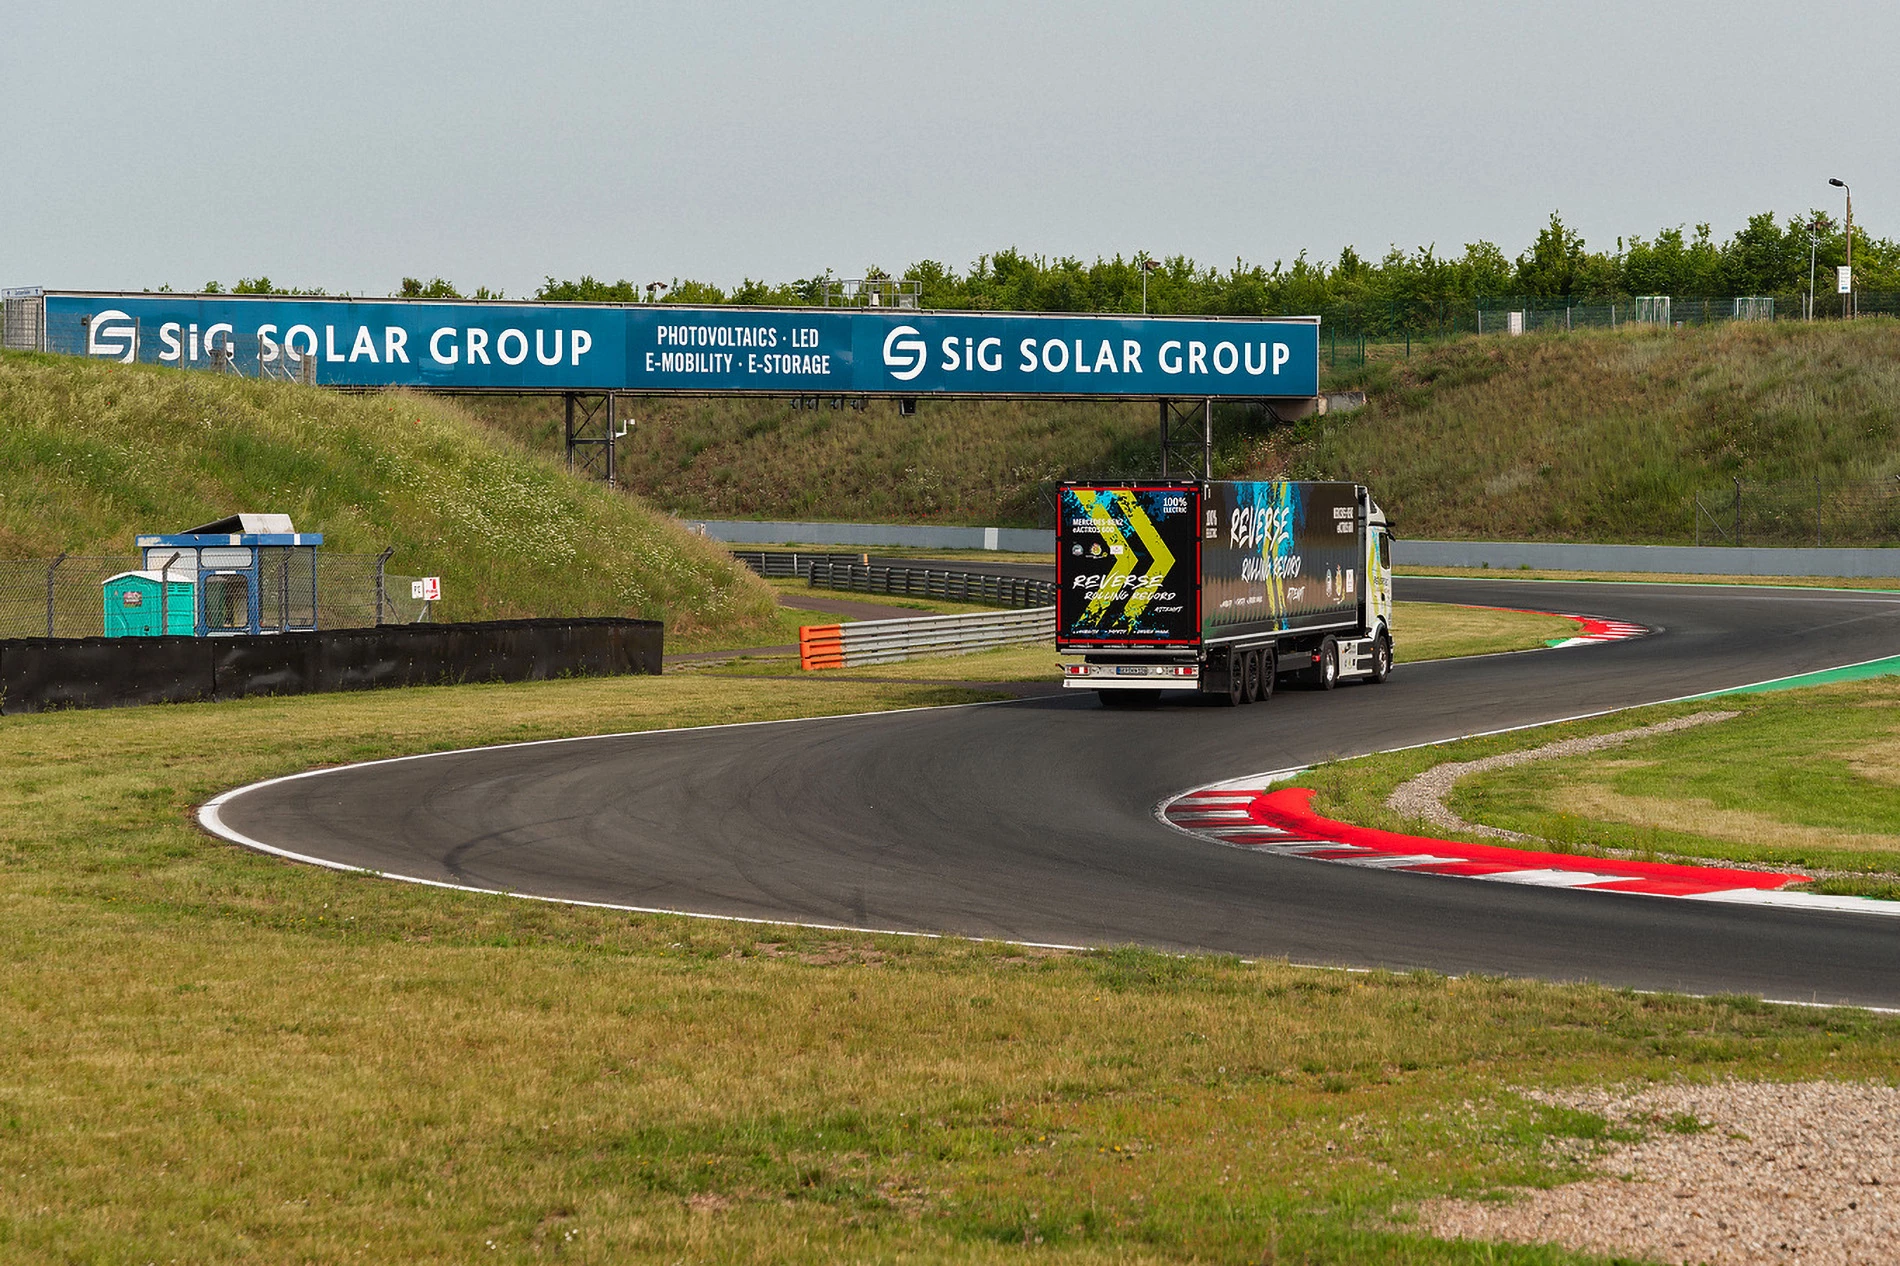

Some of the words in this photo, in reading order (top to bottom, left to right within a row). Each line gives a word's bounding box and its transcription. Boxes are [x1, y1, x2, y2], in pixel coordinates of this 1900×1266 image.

[158, 322, 234, 363] SiG
[256, 323, 410, 364] SOLAR
[430, 327, 592, 366] GROUP
[657, 325, 778, 348] PHOTOVOLTAICS
[792, 328, 820, 348] LED
[645, 352, 733, 373] E-MOBILITY
[748, 353, 831, 375] E-STORAGE
[942, 336, 1002, 372] SiG
[1020, 338, 1143, 373] SOLAR
[1159, 340, 1290, 375] GROUP
[1163, 497, 1187, 507] 100%
[1072, 518, 1124, 526] MERCEDES-BENZ
[1230, 494, 1289, 549] REVERSE
[1072, 571, 1163, 588] REVERSE
[1084, 589, 1129, 601] ROLLING
[1131, 591, 1176, 601] RECORD
